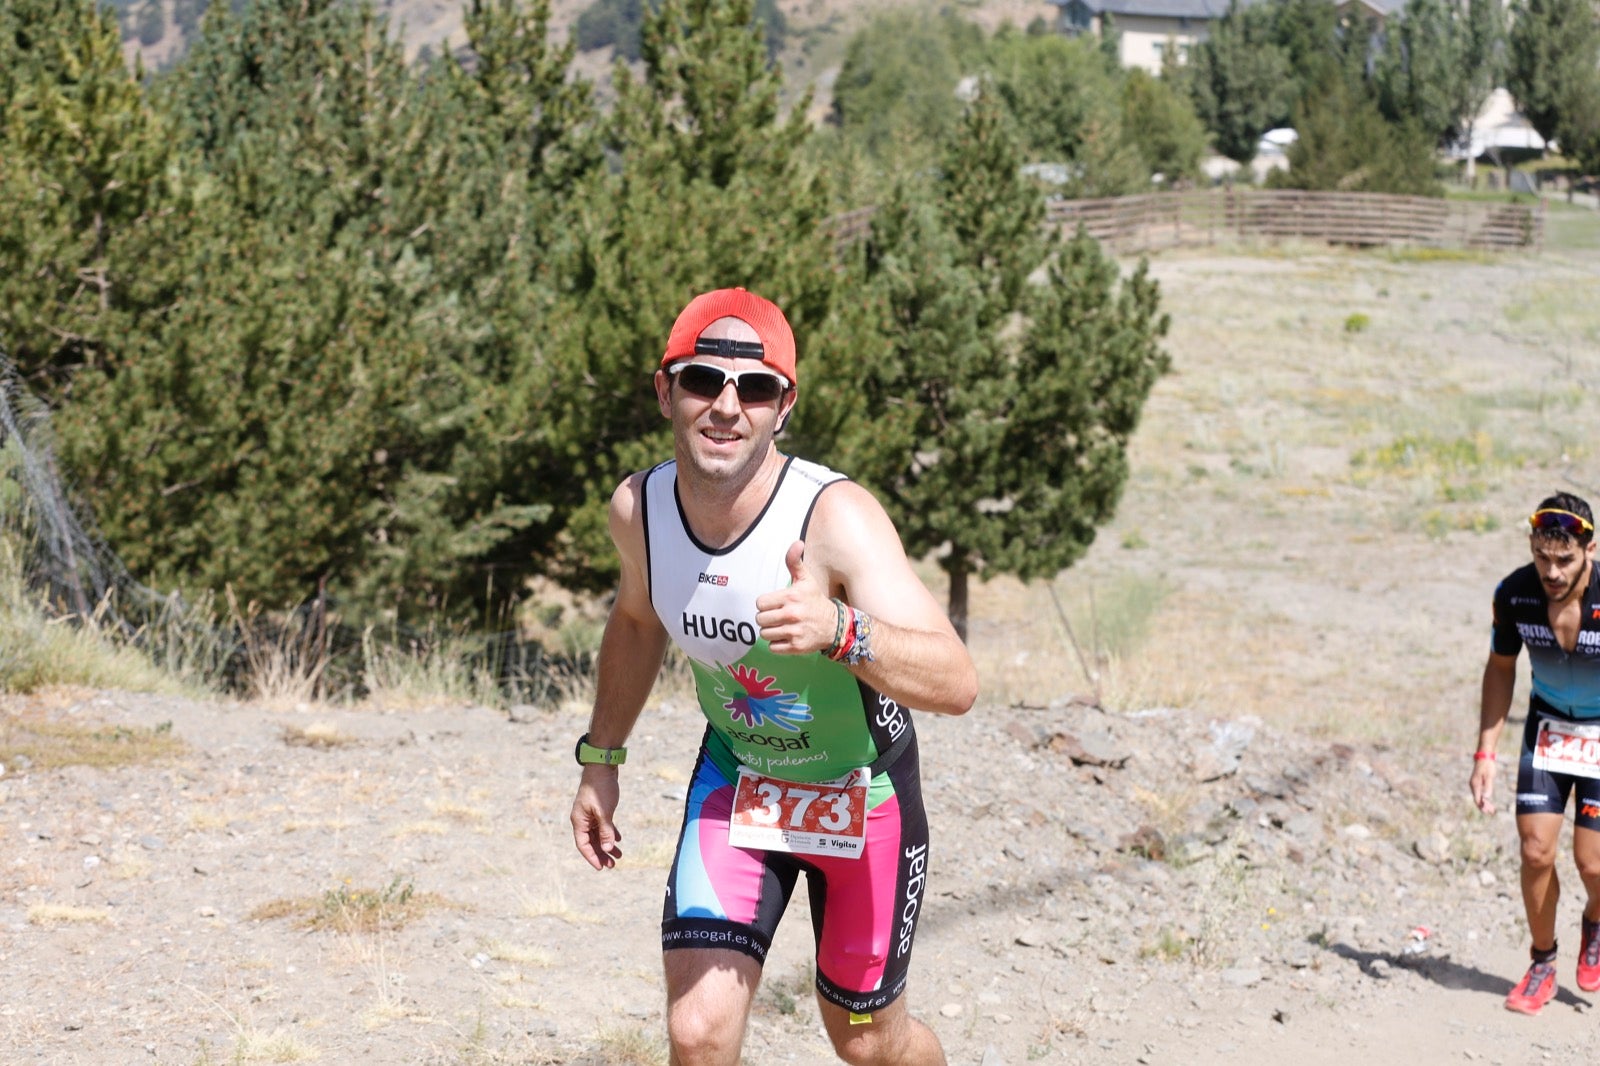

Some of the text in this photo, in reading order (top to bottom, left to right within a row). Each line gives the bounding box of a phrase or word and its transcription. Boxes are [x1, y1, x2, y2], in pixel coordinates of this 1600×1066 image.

[682, 611, 756, 646] HUGO
[725, 726, 810, 752] asogaf
[766, 750, 829, 773] podemos
[750, 783, 852, 831] 373
[831, 839, 857, 849] Vigilsa
[897, 843, 927, 959] asogaf
